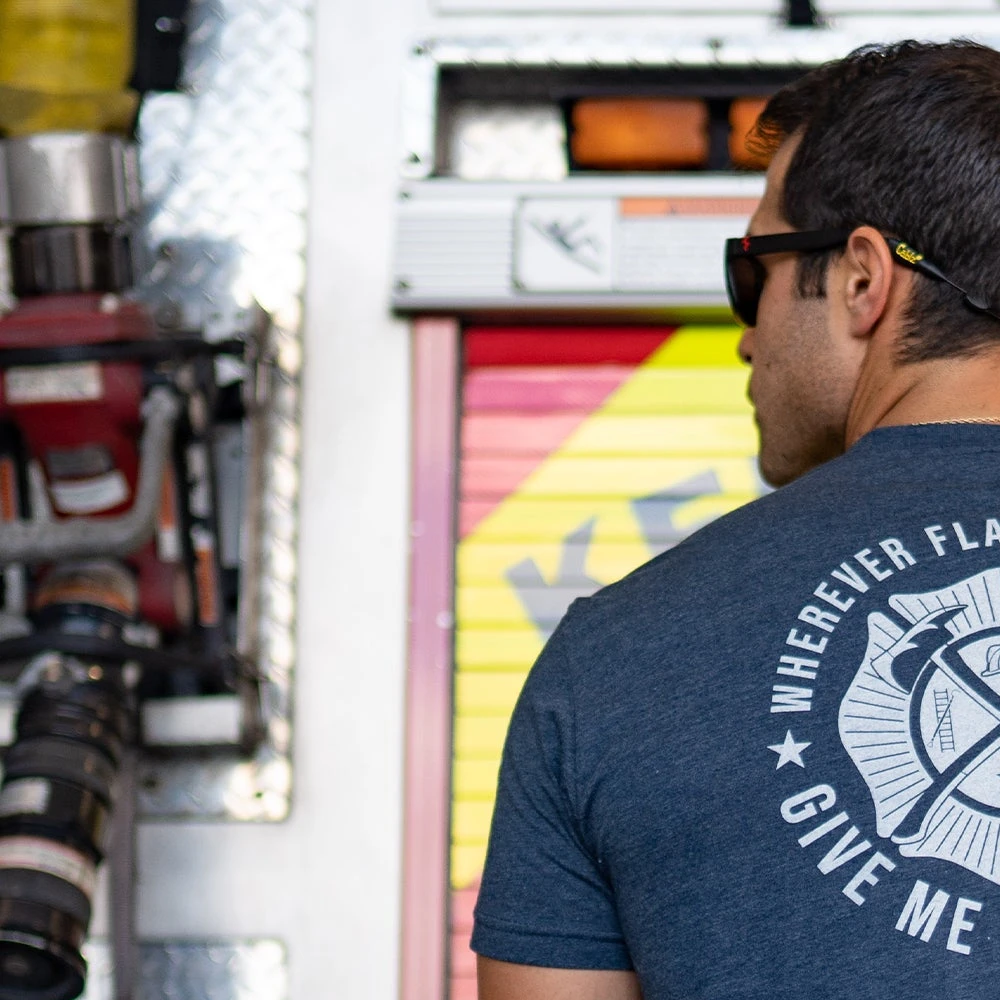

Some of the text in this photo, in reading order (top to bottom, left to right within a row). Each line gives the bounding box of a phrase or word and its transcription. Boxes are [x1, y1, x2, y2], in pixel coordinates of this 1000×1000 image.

[769, 538, 917, 714] WHEREVER
[780, 783, 897, 907] GIVE
[894, 879, 983, 956] ME
